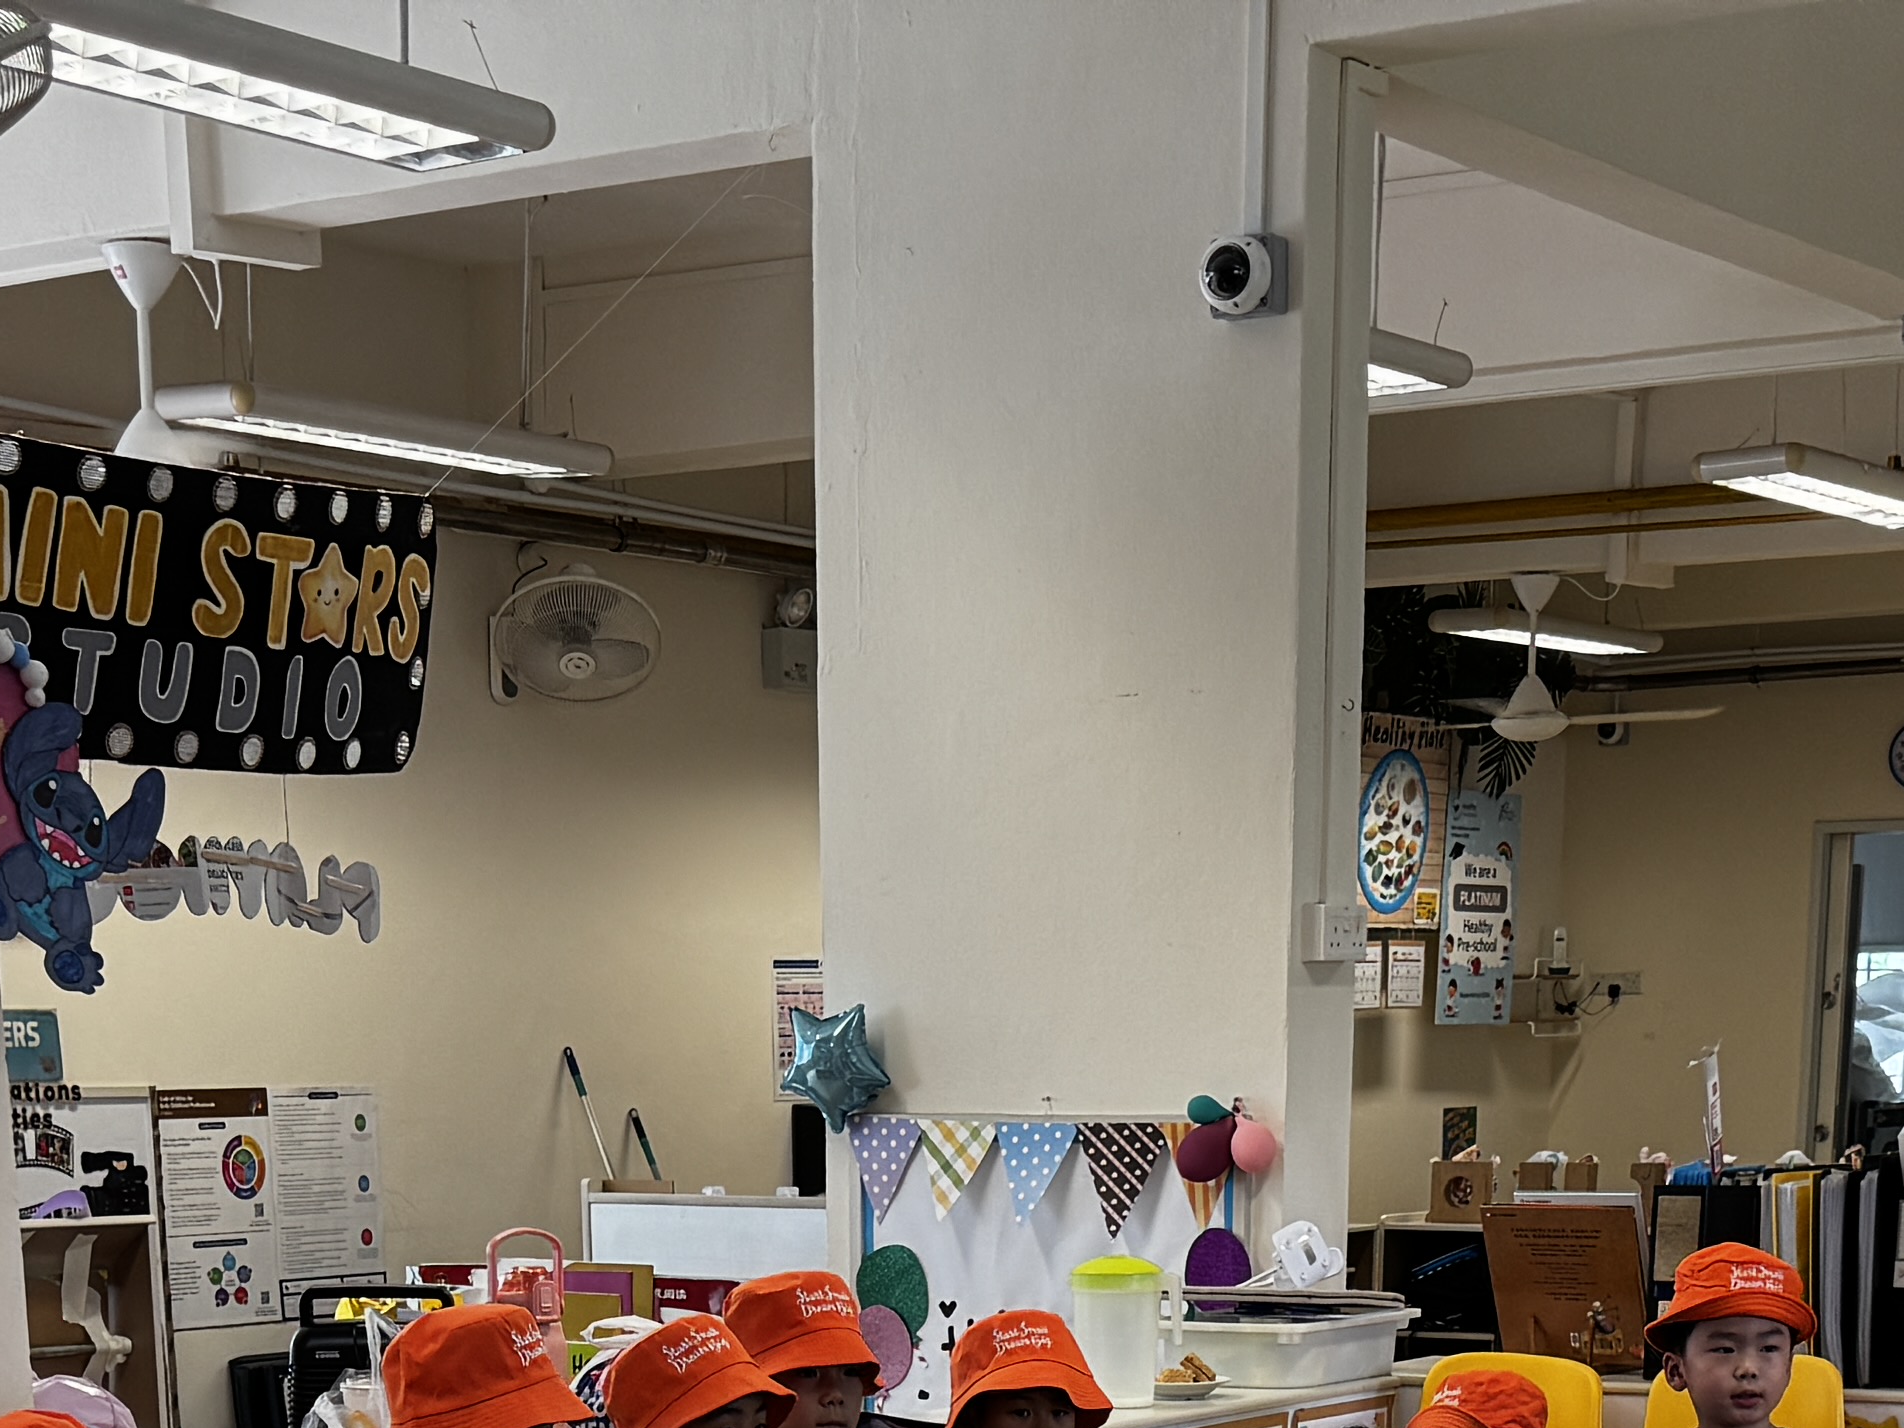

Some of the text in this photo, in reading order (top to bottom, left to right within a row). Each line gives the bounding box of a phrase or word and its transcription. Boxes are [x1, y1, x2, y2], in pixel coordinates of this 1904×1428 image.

[192, 518, 432, 664] STRS
[1459, 890, 1501, 906] PLATINUM
[3, 1020, 41, 1048] ERS
[10, 1082, 82, 1103] ations
[11, 1107, 54, 1130] ties
